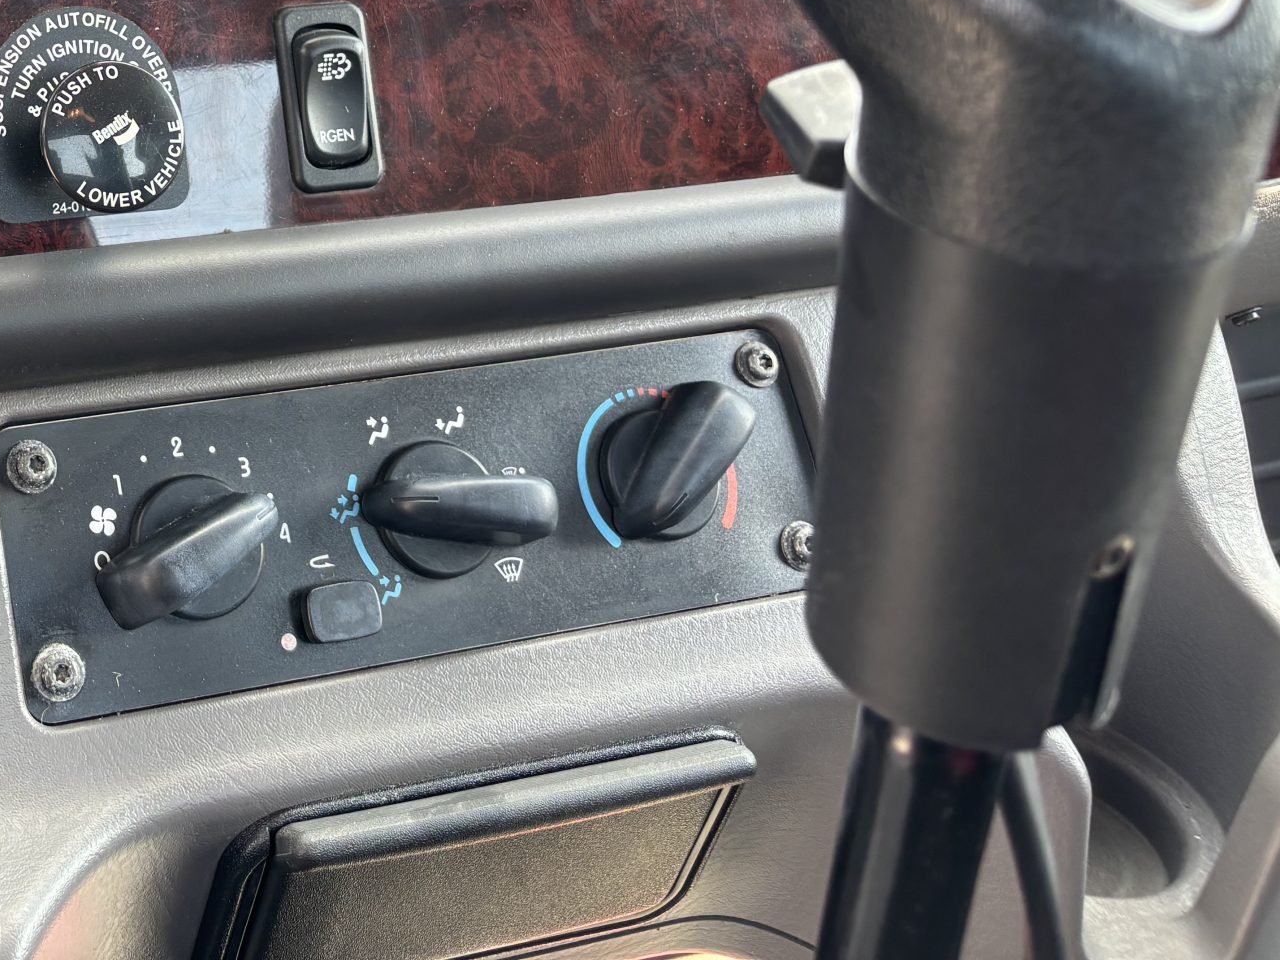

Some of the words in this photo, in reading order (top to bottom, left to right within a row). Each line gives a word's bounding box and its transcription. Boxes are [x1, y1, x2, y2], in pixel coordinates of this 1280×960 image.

[45, 12, 129, 41] AUTOFILL
[11, 54, 47, 100] TURN
[46, 39, 124, 62] IGNITION
[52, 72, 92, 117] PUSH
[94, 65, 119, 81] TO
[92, 111, 134, 145] Bendix
[320, 128, 355, 144] RGEN
[77, 181, 144, 208] LOWER
[144, 119, 182, 196] VEHICLE
[170, 436, 184, 457] 2
[238, 457, 251, 478] 3
[112, 474, 122, 495] 1
[279, 522, 292, 543] 4
